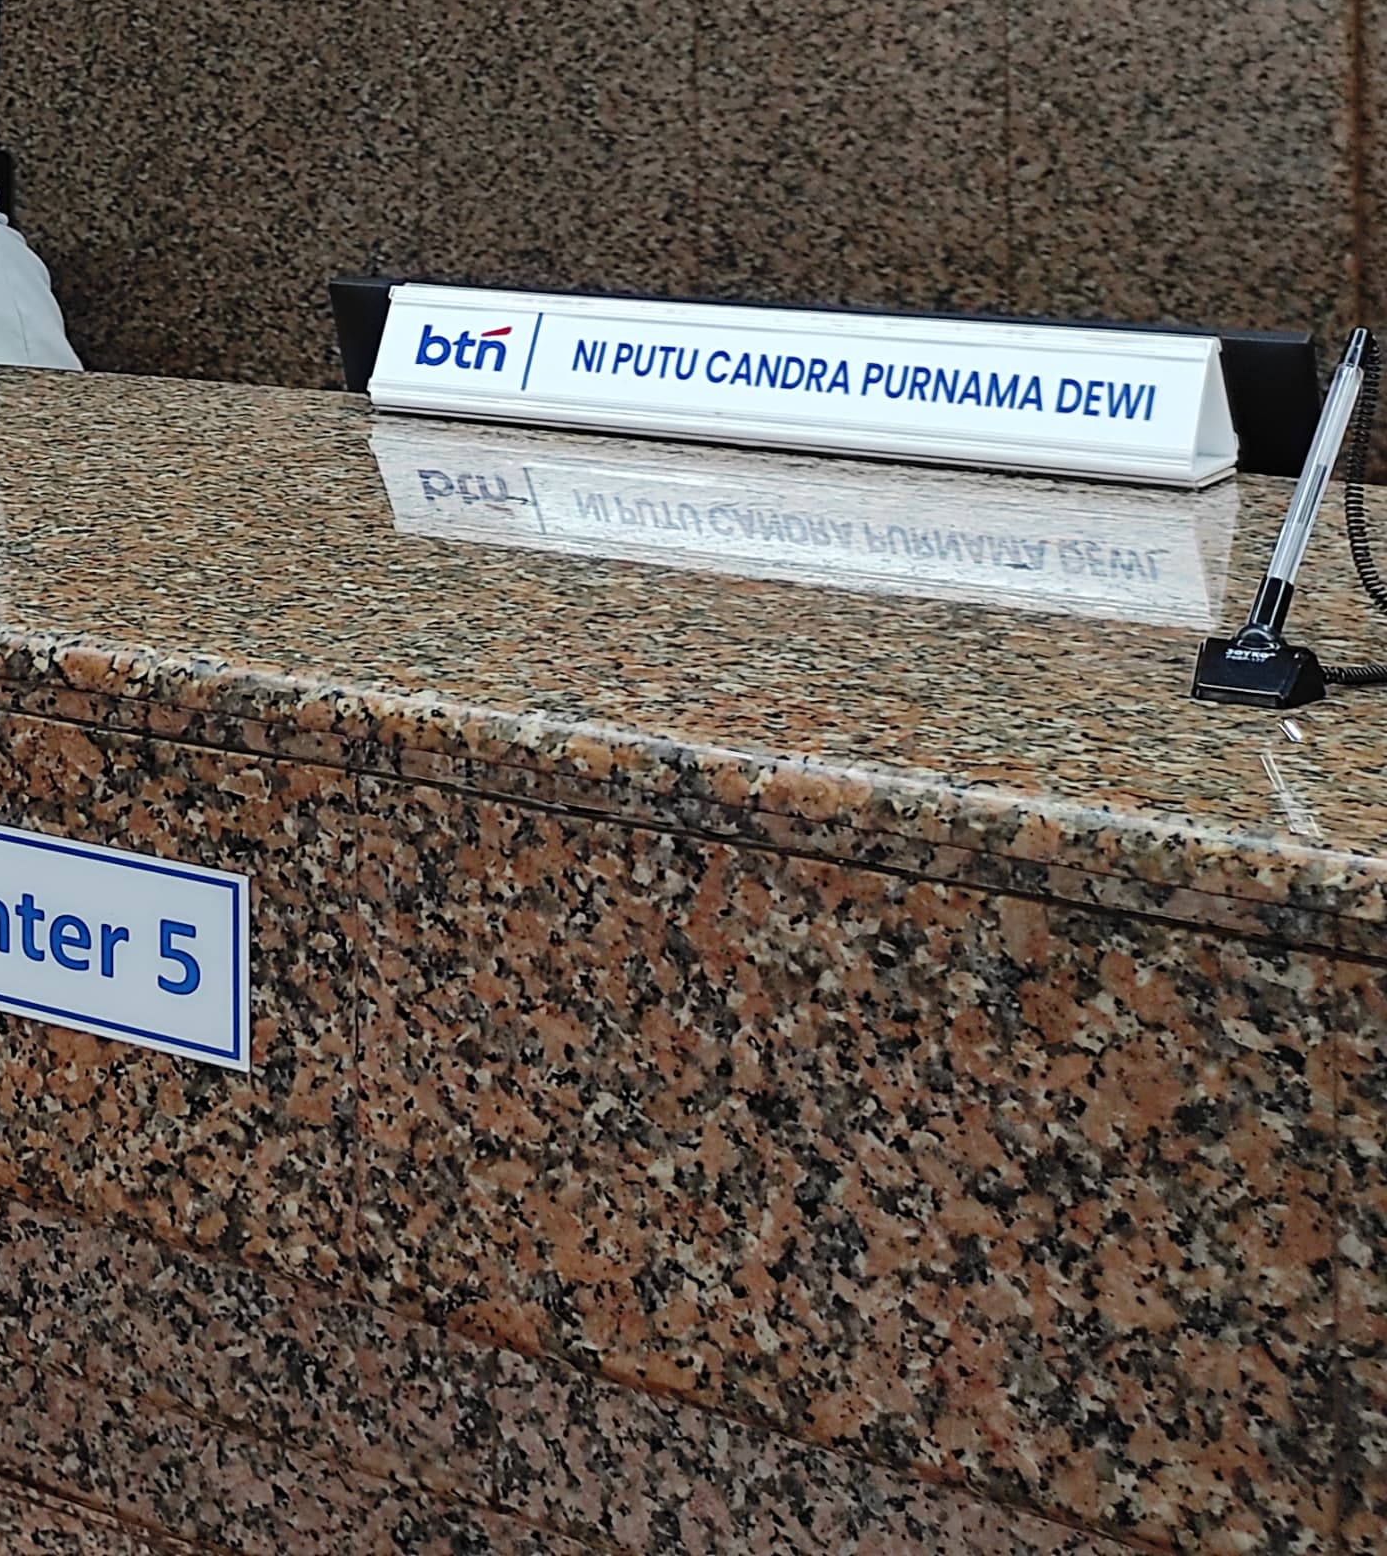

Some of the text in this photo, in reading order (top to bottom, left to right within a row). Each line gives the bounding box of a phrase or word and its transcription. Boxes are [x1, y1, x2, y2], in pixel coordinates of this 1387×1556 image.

[415, 324, 1157, 421] btn NI PUTU CANDRA PURNAMA DEWI
[156, 918, 202, 996] 5
